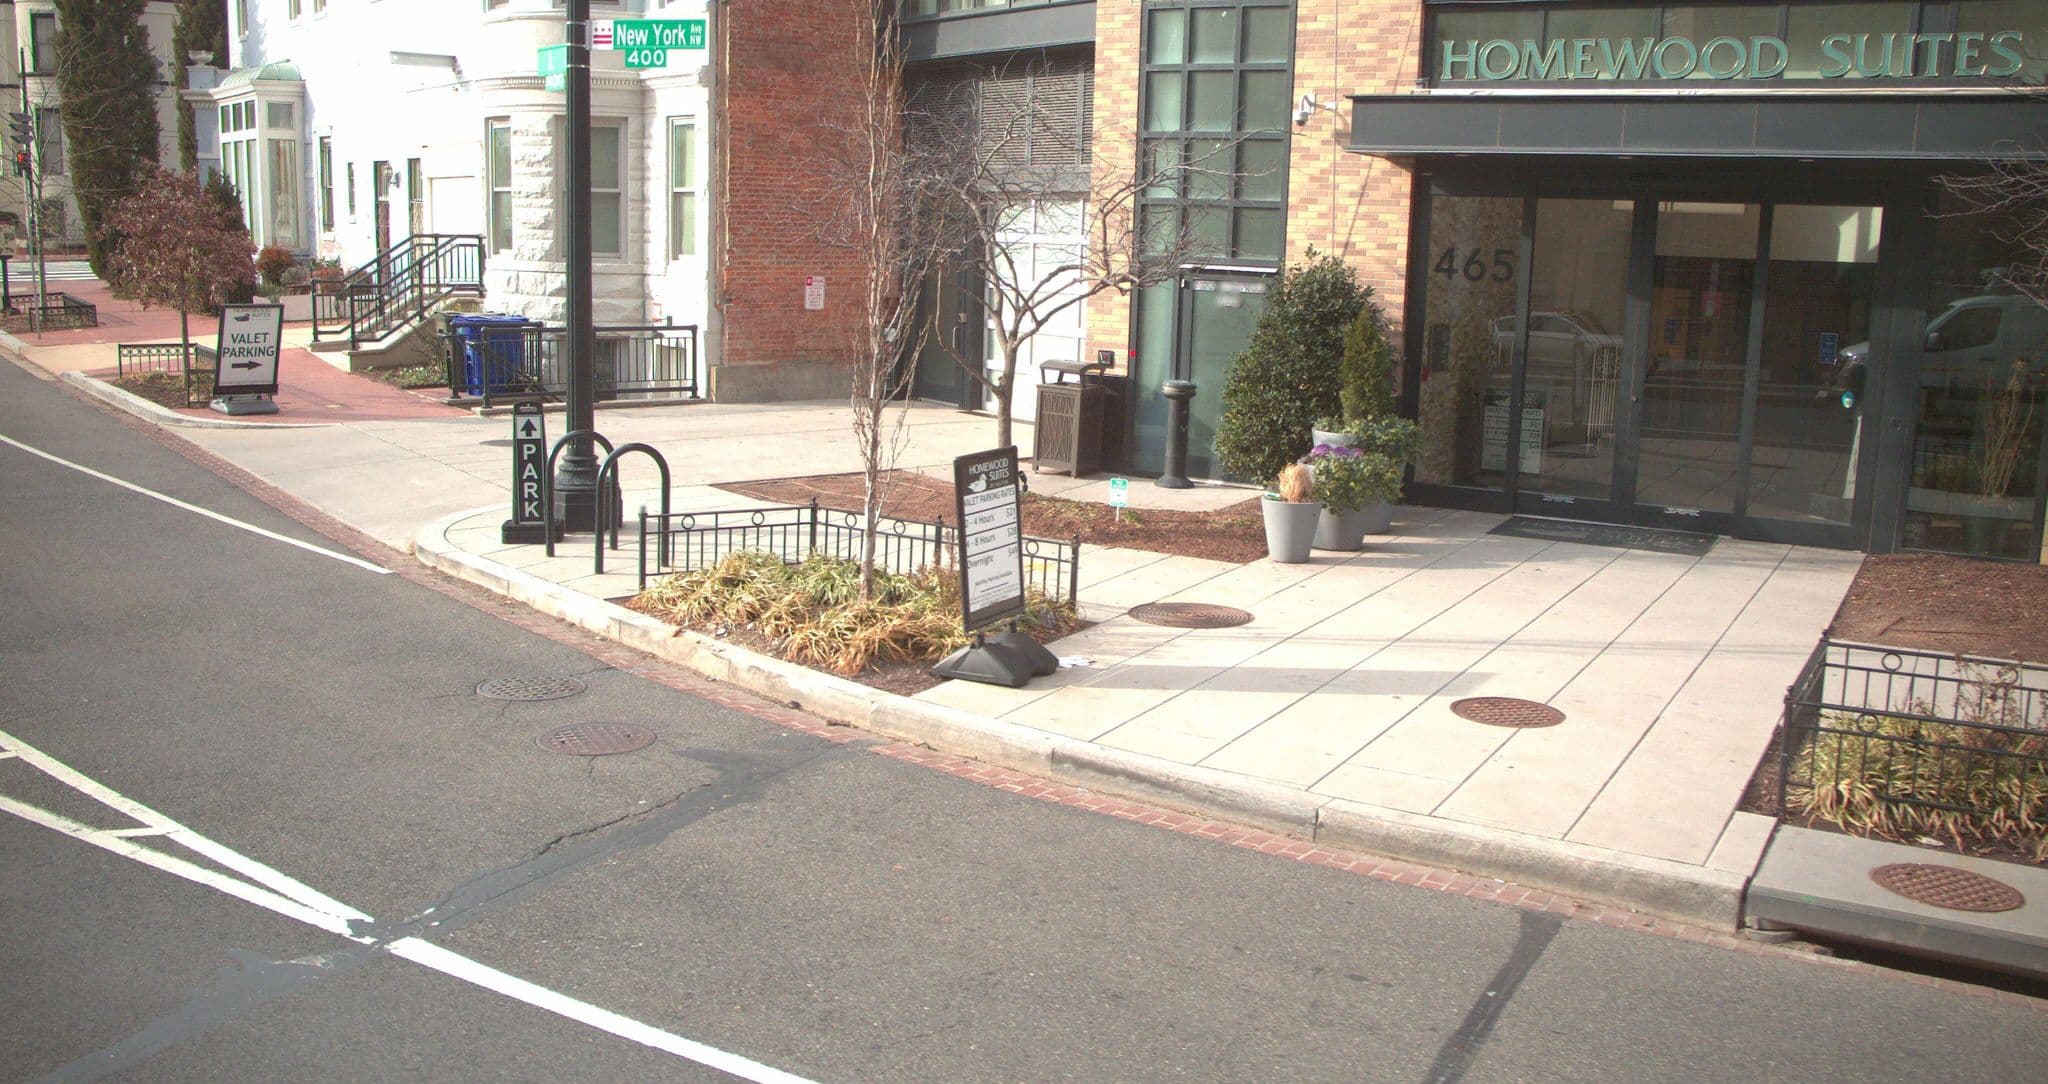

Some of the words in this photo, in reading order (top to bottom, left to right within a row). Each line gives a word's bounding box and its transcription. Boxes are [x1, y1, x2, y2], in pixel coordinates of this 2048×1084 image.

[616, 24, 648, 46] New
[653, 23, 686, 46] York
[690, 24, 702, 34] Ave
[690, 35, 701, 45] NW
[628, 50, 665, 66] 400
[1440, 36, 1789, 81] HOMEWOOD
[1819, 30, 2024, 79] SUITES
[1434, 247, 1514, 282] 465
[231, 332, 269, 344] VALET
[222, 345, 275, 358] PARKING
[968, 458, 1009, 476] HOMEWOOD
[989, 468, 1010, 481] SUITES
[522, 444, 540, 518] PARK
[978, 514, 995, 525] Hours
[979, 534, 996, 545] Hours
[967, 554, 994, 570] Overnight
